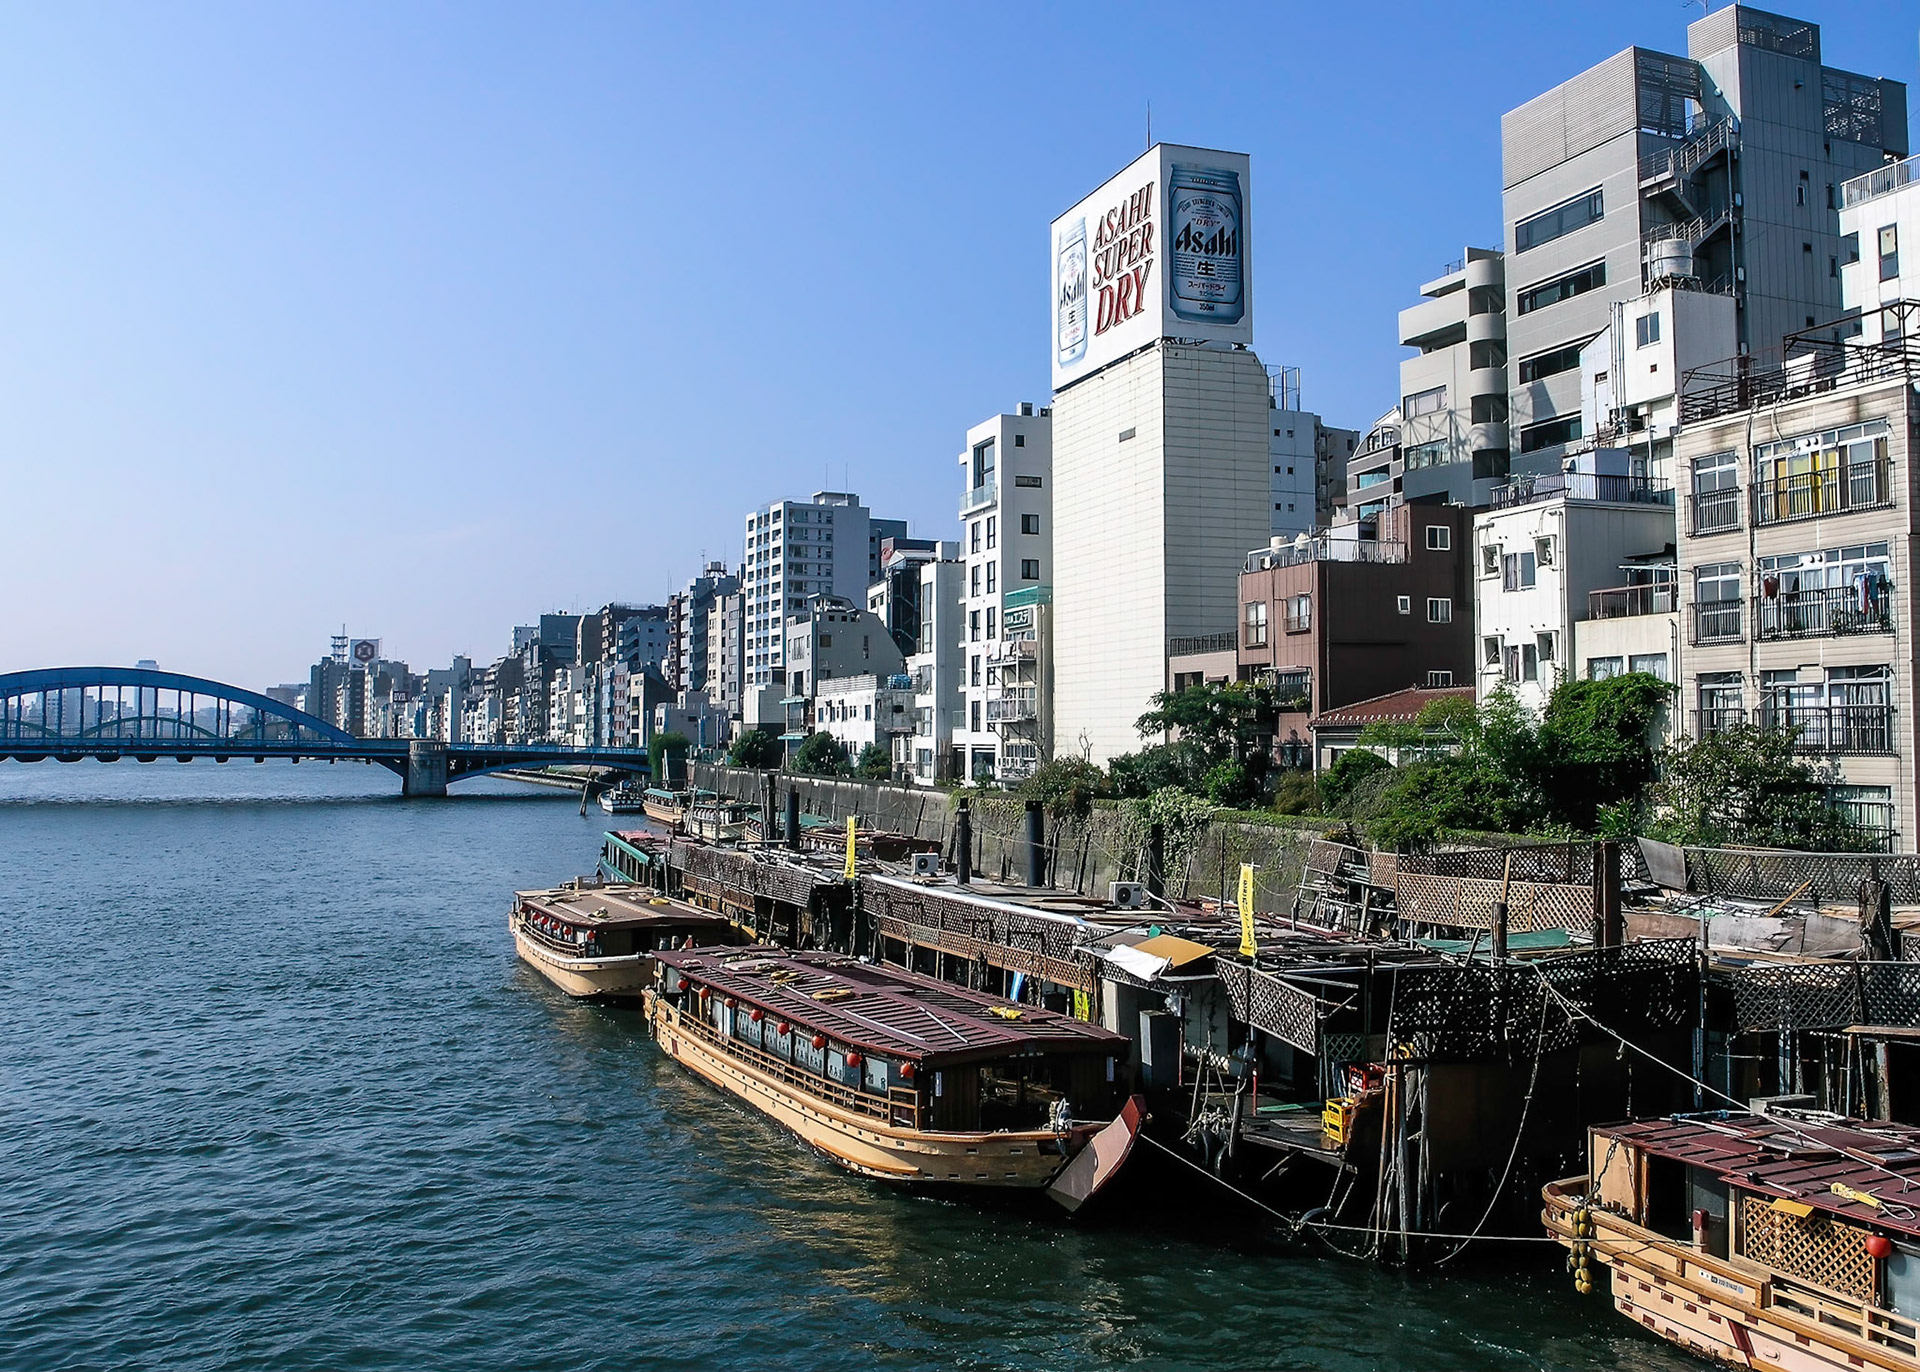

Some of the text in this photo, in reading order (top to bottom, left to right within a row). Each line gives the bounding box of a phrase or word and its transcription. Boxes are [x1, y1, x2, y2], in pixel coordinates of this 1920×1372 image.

[1092, 181, 1155, 252] ASAHI
[1093, 221, 1154, 289] SUPER
[1175, 221, 1237, 257] Asahi
[1188, 281, 1227, 291] スーパードライ
[1197, 260, 1216, 277] 生
[1060, 270, 1085, 309] Asahi
[1094, 258, 1154, 337] DRY
